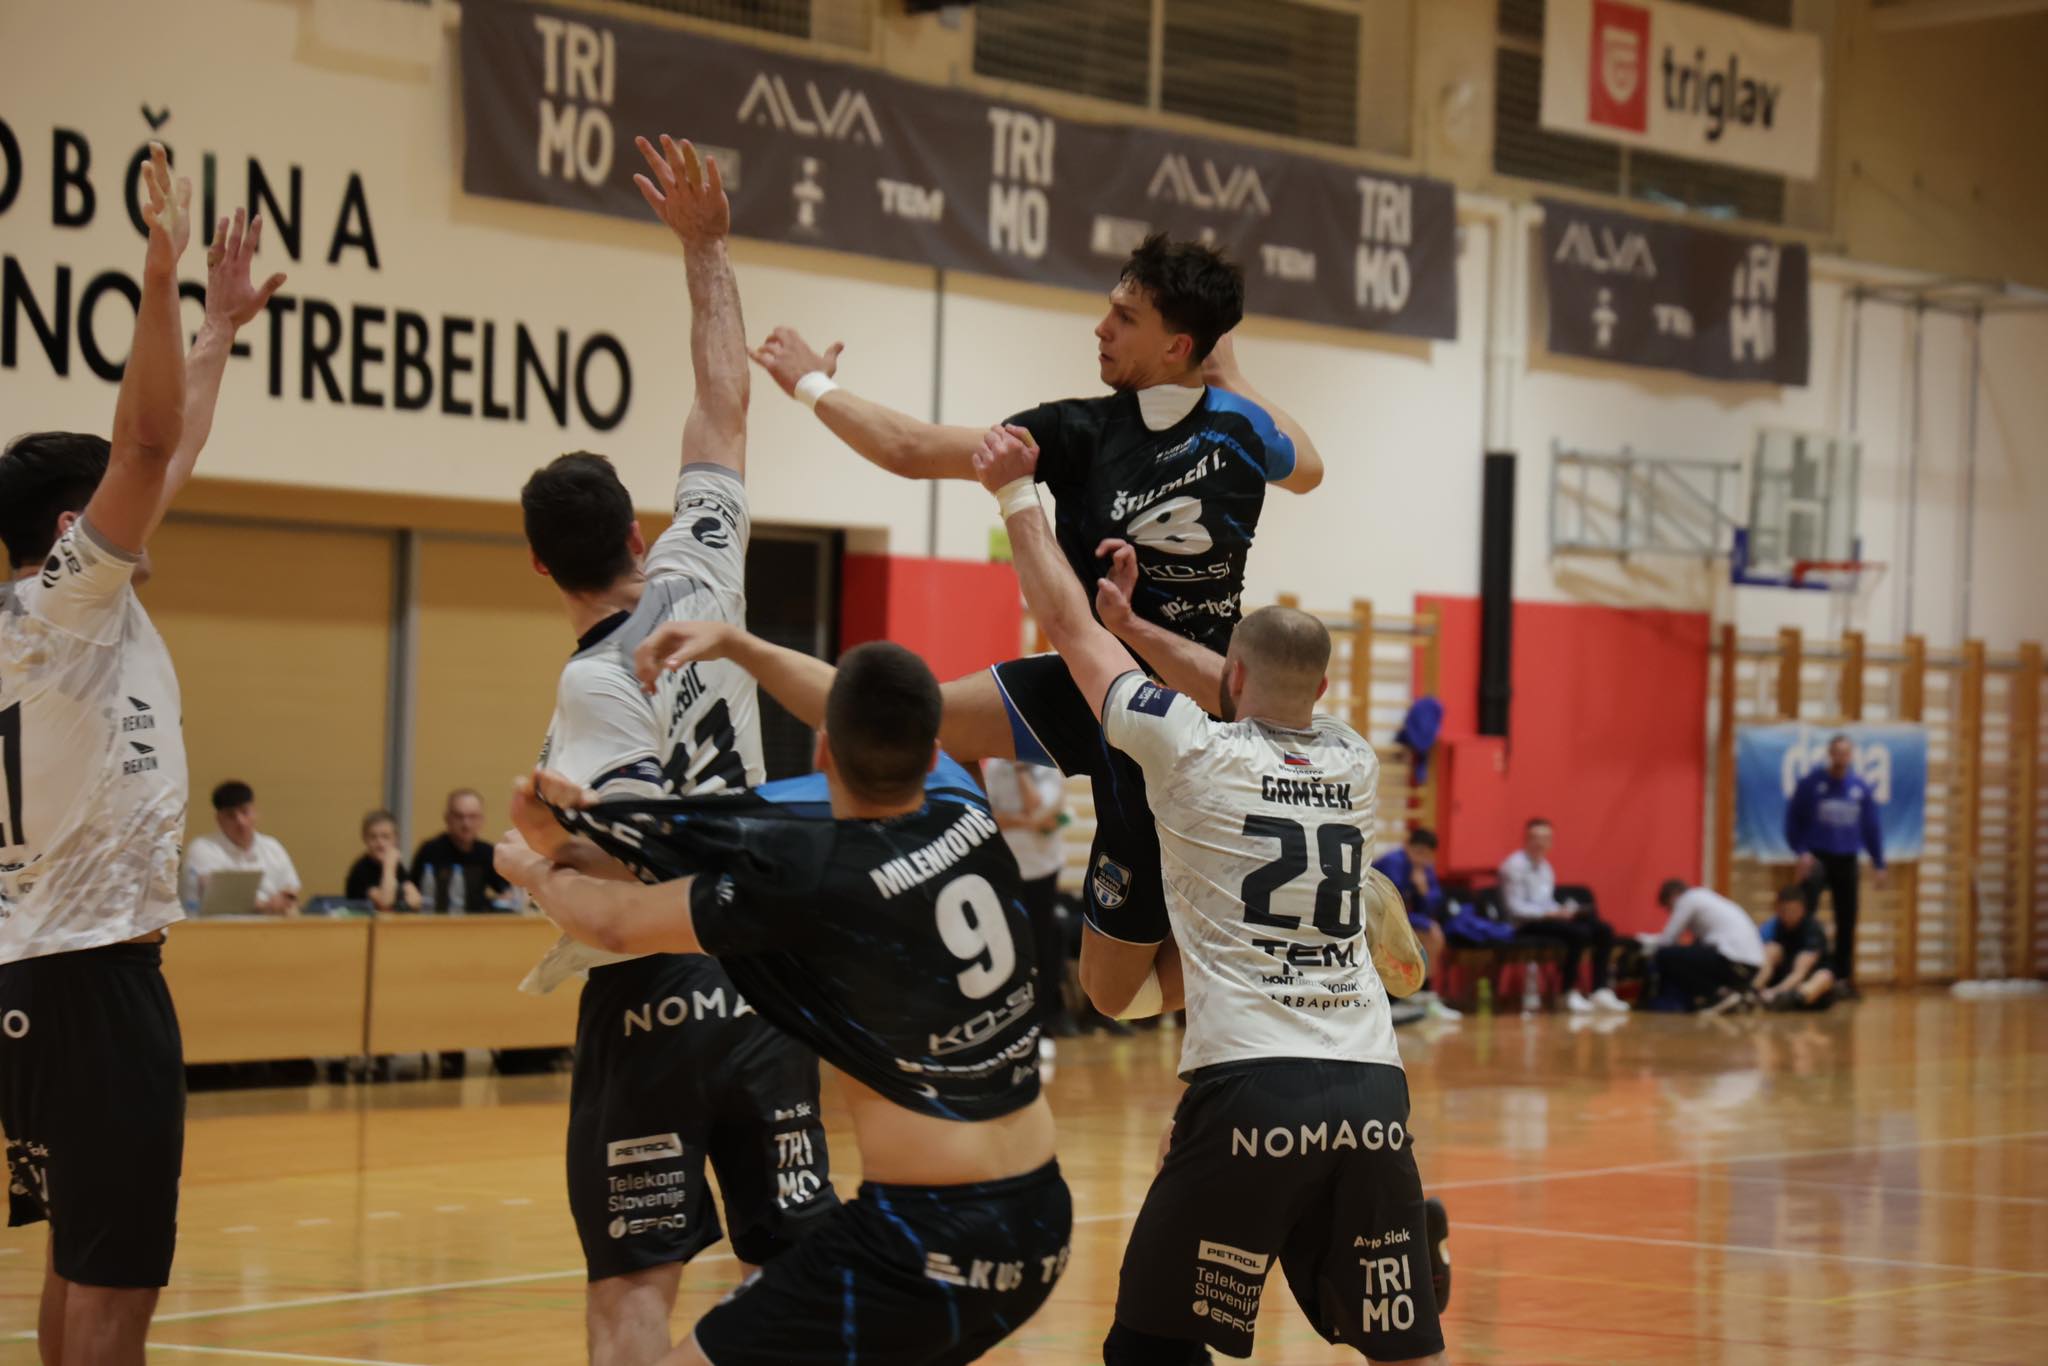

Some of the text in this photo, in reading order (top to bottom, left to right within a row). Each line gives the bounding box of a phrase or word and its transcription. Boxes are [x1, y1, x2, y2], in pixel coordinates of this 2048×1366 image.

[534, 15, 617, 106] TRI
[1662, 42, 1782, 142] triglav
[736, 72, 884, 146] ALVA
[537, 100, 615, 187] MO
[987, 106, 1056, 185] TRI
[1147, 153, 1271, 217] ALVA
[1356, 175, 1414, 246] TRI
[988, 181, 1050, 259] MO
[1355, 243, 1412, 314] MO
[0, 254, 633, 433] NO-TREBELNO
[122, 714, 156, 732] REKON
[122, 756, 159, 776] REKON
[1261, 774, 1353, 811] GRMŠEK
[1240, 813, 1365, 939] 28
[934, 872, 1017, 1000] 9
[1231, 1118, 1405, 1158] NOMAGO
[607, 1170, 686, 1193] Telekom
[607, 1186, 686, 1213] Slovenije
[1206, 1247, 1261, 1269] PETROL
[1384, 1228, 1411, 1245] Slak
[1196, 1266, 1263, 1297] Telekom
[1359, 1253, 1411, 1295] TRI
[1361, 1294, 1415, 1333] MO
